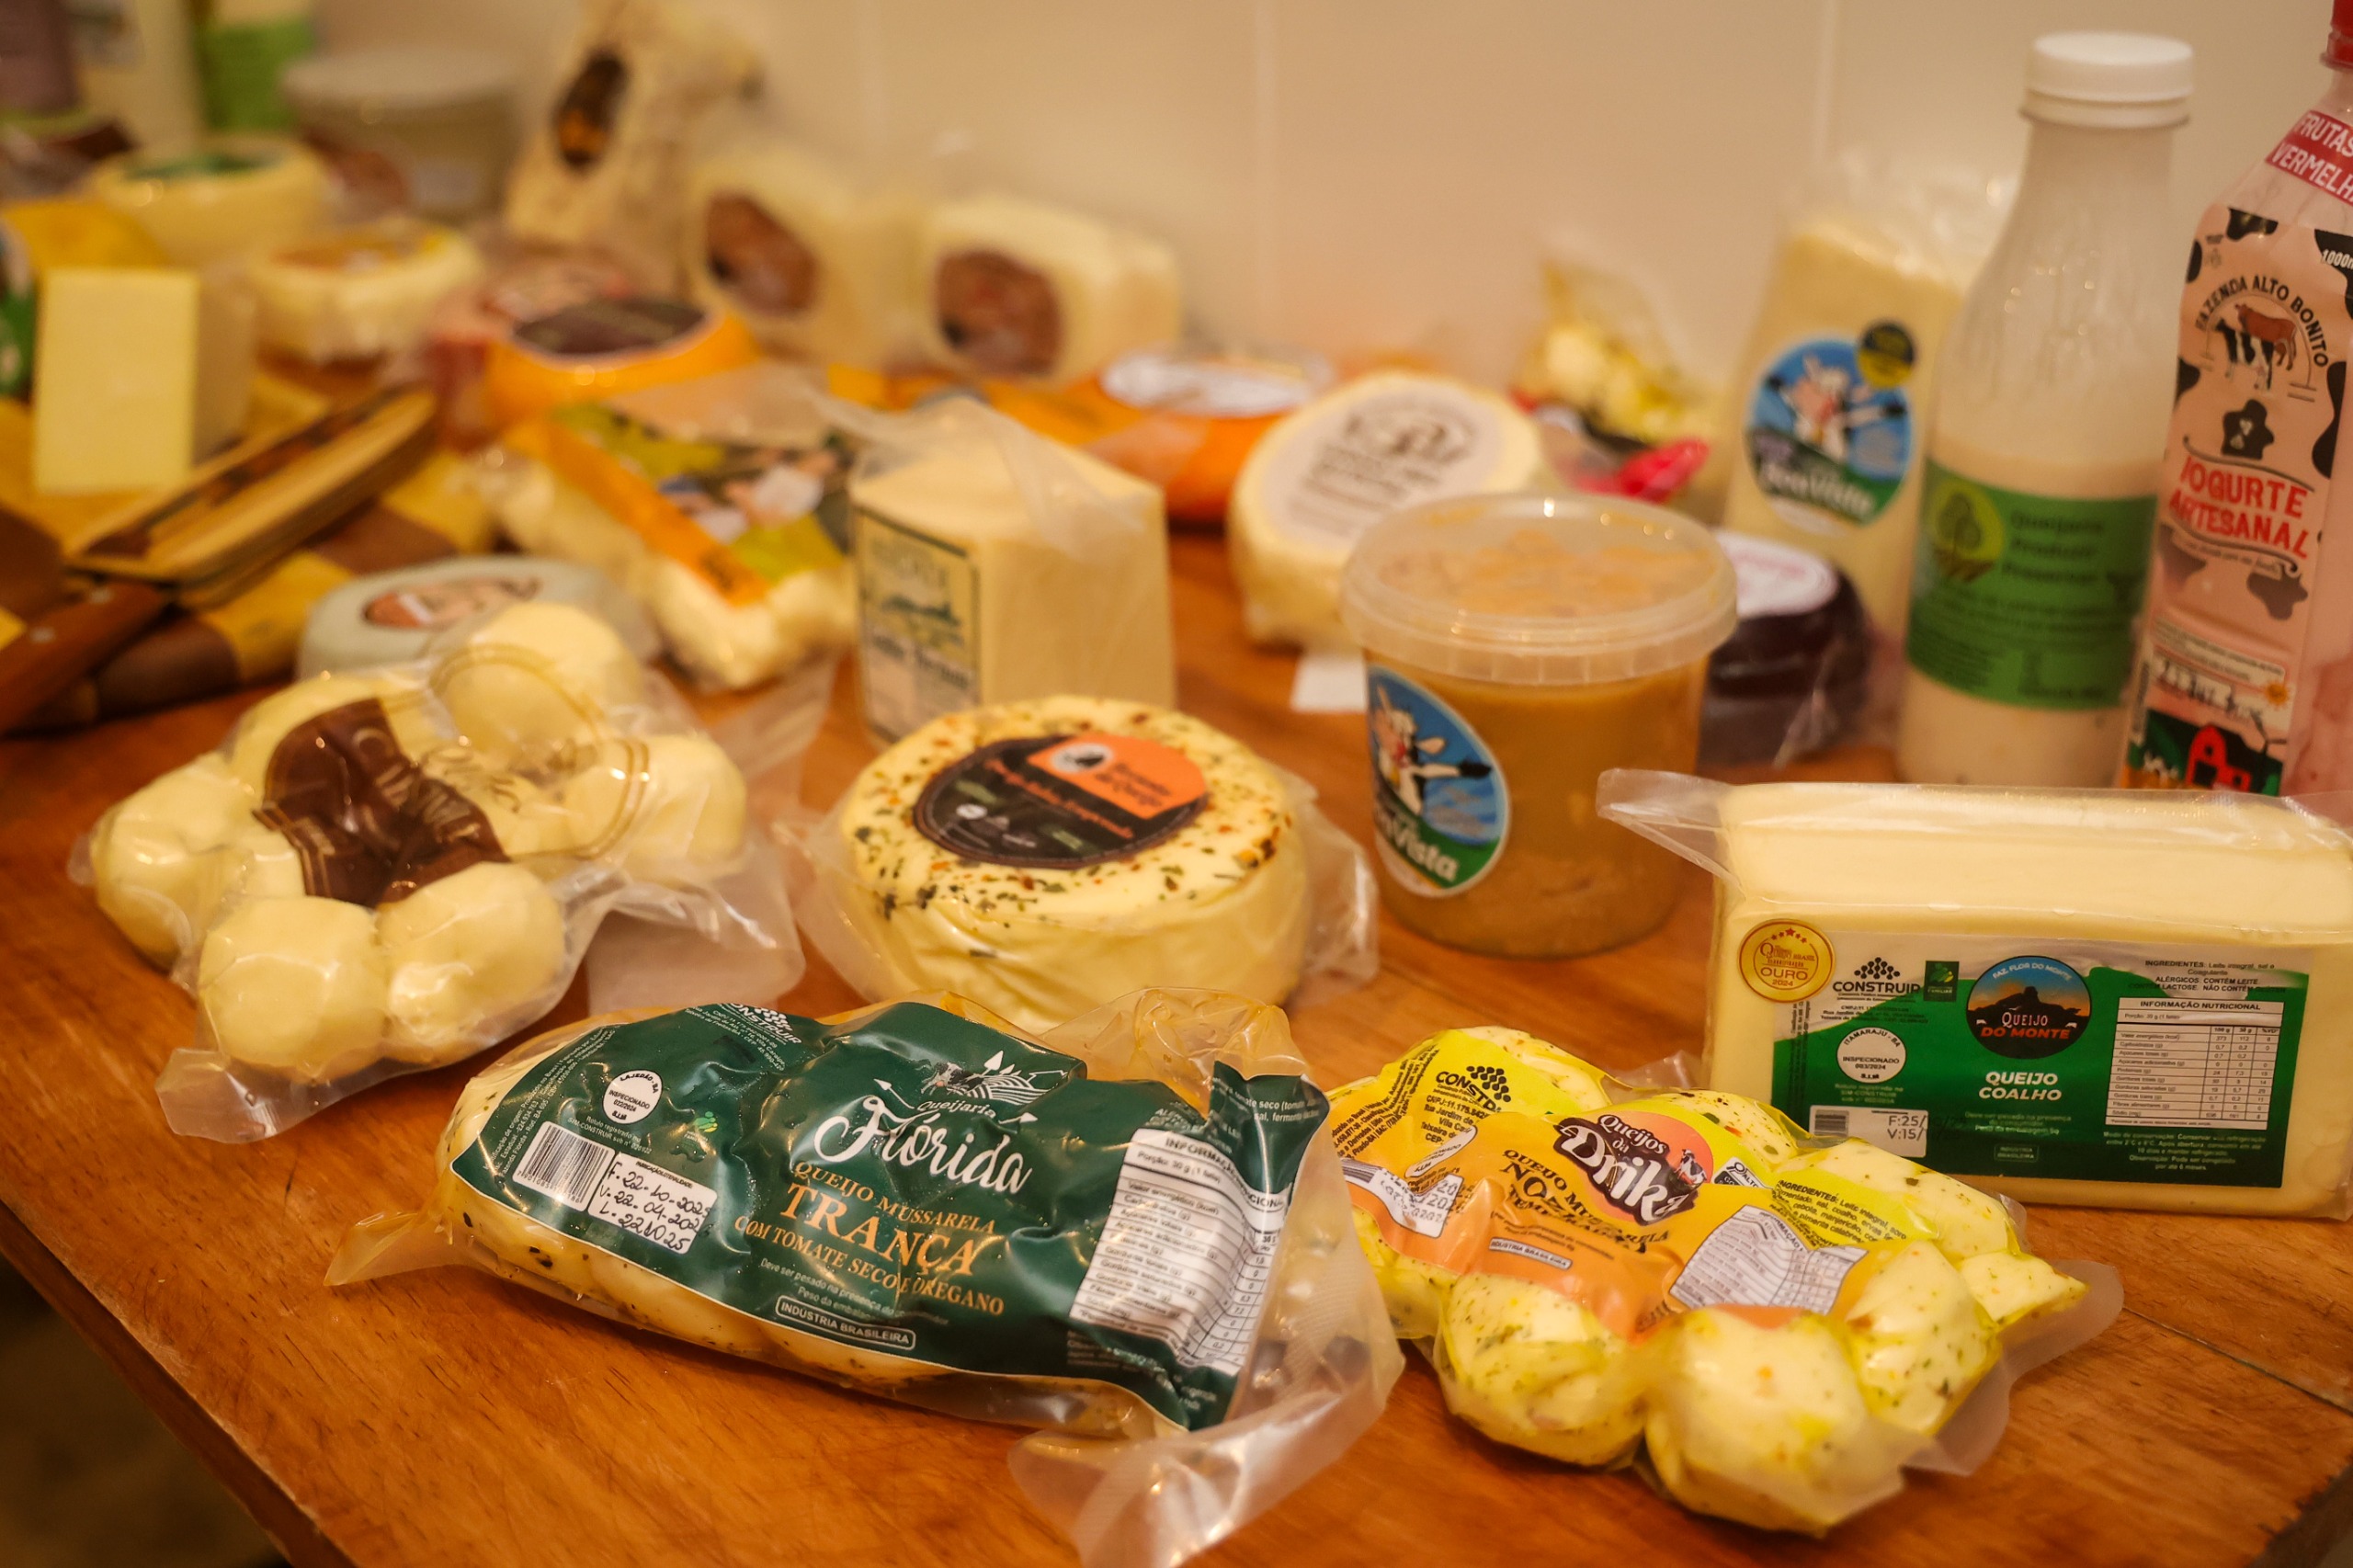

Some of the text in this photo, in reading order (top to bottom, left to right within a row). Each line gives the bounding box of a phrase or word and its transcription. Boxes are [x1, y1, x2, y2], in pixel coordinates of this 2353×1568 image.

[2296, 112, 2353, 158] FRUTAS
[2272, 141, 2353, 204] VERMELH
[2195, 275, 2329, 369] FAZENDA ALTO BONITO
[2179, 457, 2308, 518] IOGURTE
[2169, 490, 2310, 559] ARTESANAL
[1760, 967, 1808, 981] OURO
[2009, 963, 2029, 971] FLOR
[1772, 979, 1793, 987] 2024
[2140, 1001, 2200, 1009] INFORMAÇÃO
[730, 1003, 802, 1044] ONSTRUIR
[2002, 1012, 2048, 1028] QUEIJO
[1844, 1028, 1901, 1048] ITAMARAJU BA
[1981, 1027, 2071, 1040] DO MONTE
[1843, 1056, 1900, 1064] INSPECIONADO
[1985, 1072, 2058, 1085] QUEIJO
[652, 1082, 660, 1094] BA
[1978, 1087, 2062, 1101] COALHO
[608, 1089, 651, 1109] INSPECIONADO
[613, 1099, 637, 1112] 022/2024
[1259, 1100, 1280, 1110] seco
[916, 1100, 996, 1119] Queijaria
[1436, 1107, 1463, 1121] Jardim
[1421, 1121, 1448, 1137] Teixeira
[1438, 1117, 1452, 1129] Vila
[814, 1095, 1032, 1194] Flórida
[1599, 1115, 1668, 1156] Queijos
[1612, 1136, 1630, 1154] da
[1503, 1150, 1568, 1191] QUEIJO
[794, 1160, 996, 1234] QUEIJO MUSSARELA
[1799, 1213, 1829, 1230] pimenta
[1839, 1199, 1859, 1212] Leite
[1890, 1227, 1907, 1240] soro
[780, 1182, 976, 1277] TRANÇA
[734, 1215, 1005, 1316] COM TOMATE SECO E OREGANO
[761, 1257, 779, 1274] Deve
[780, 1266, 795, 1277] ser
[795, 1268, 826, 1291] pesado
[797, 1286, 820, 1303] Peso
[840, 1324, 910, 1345] BRASILEIRA
